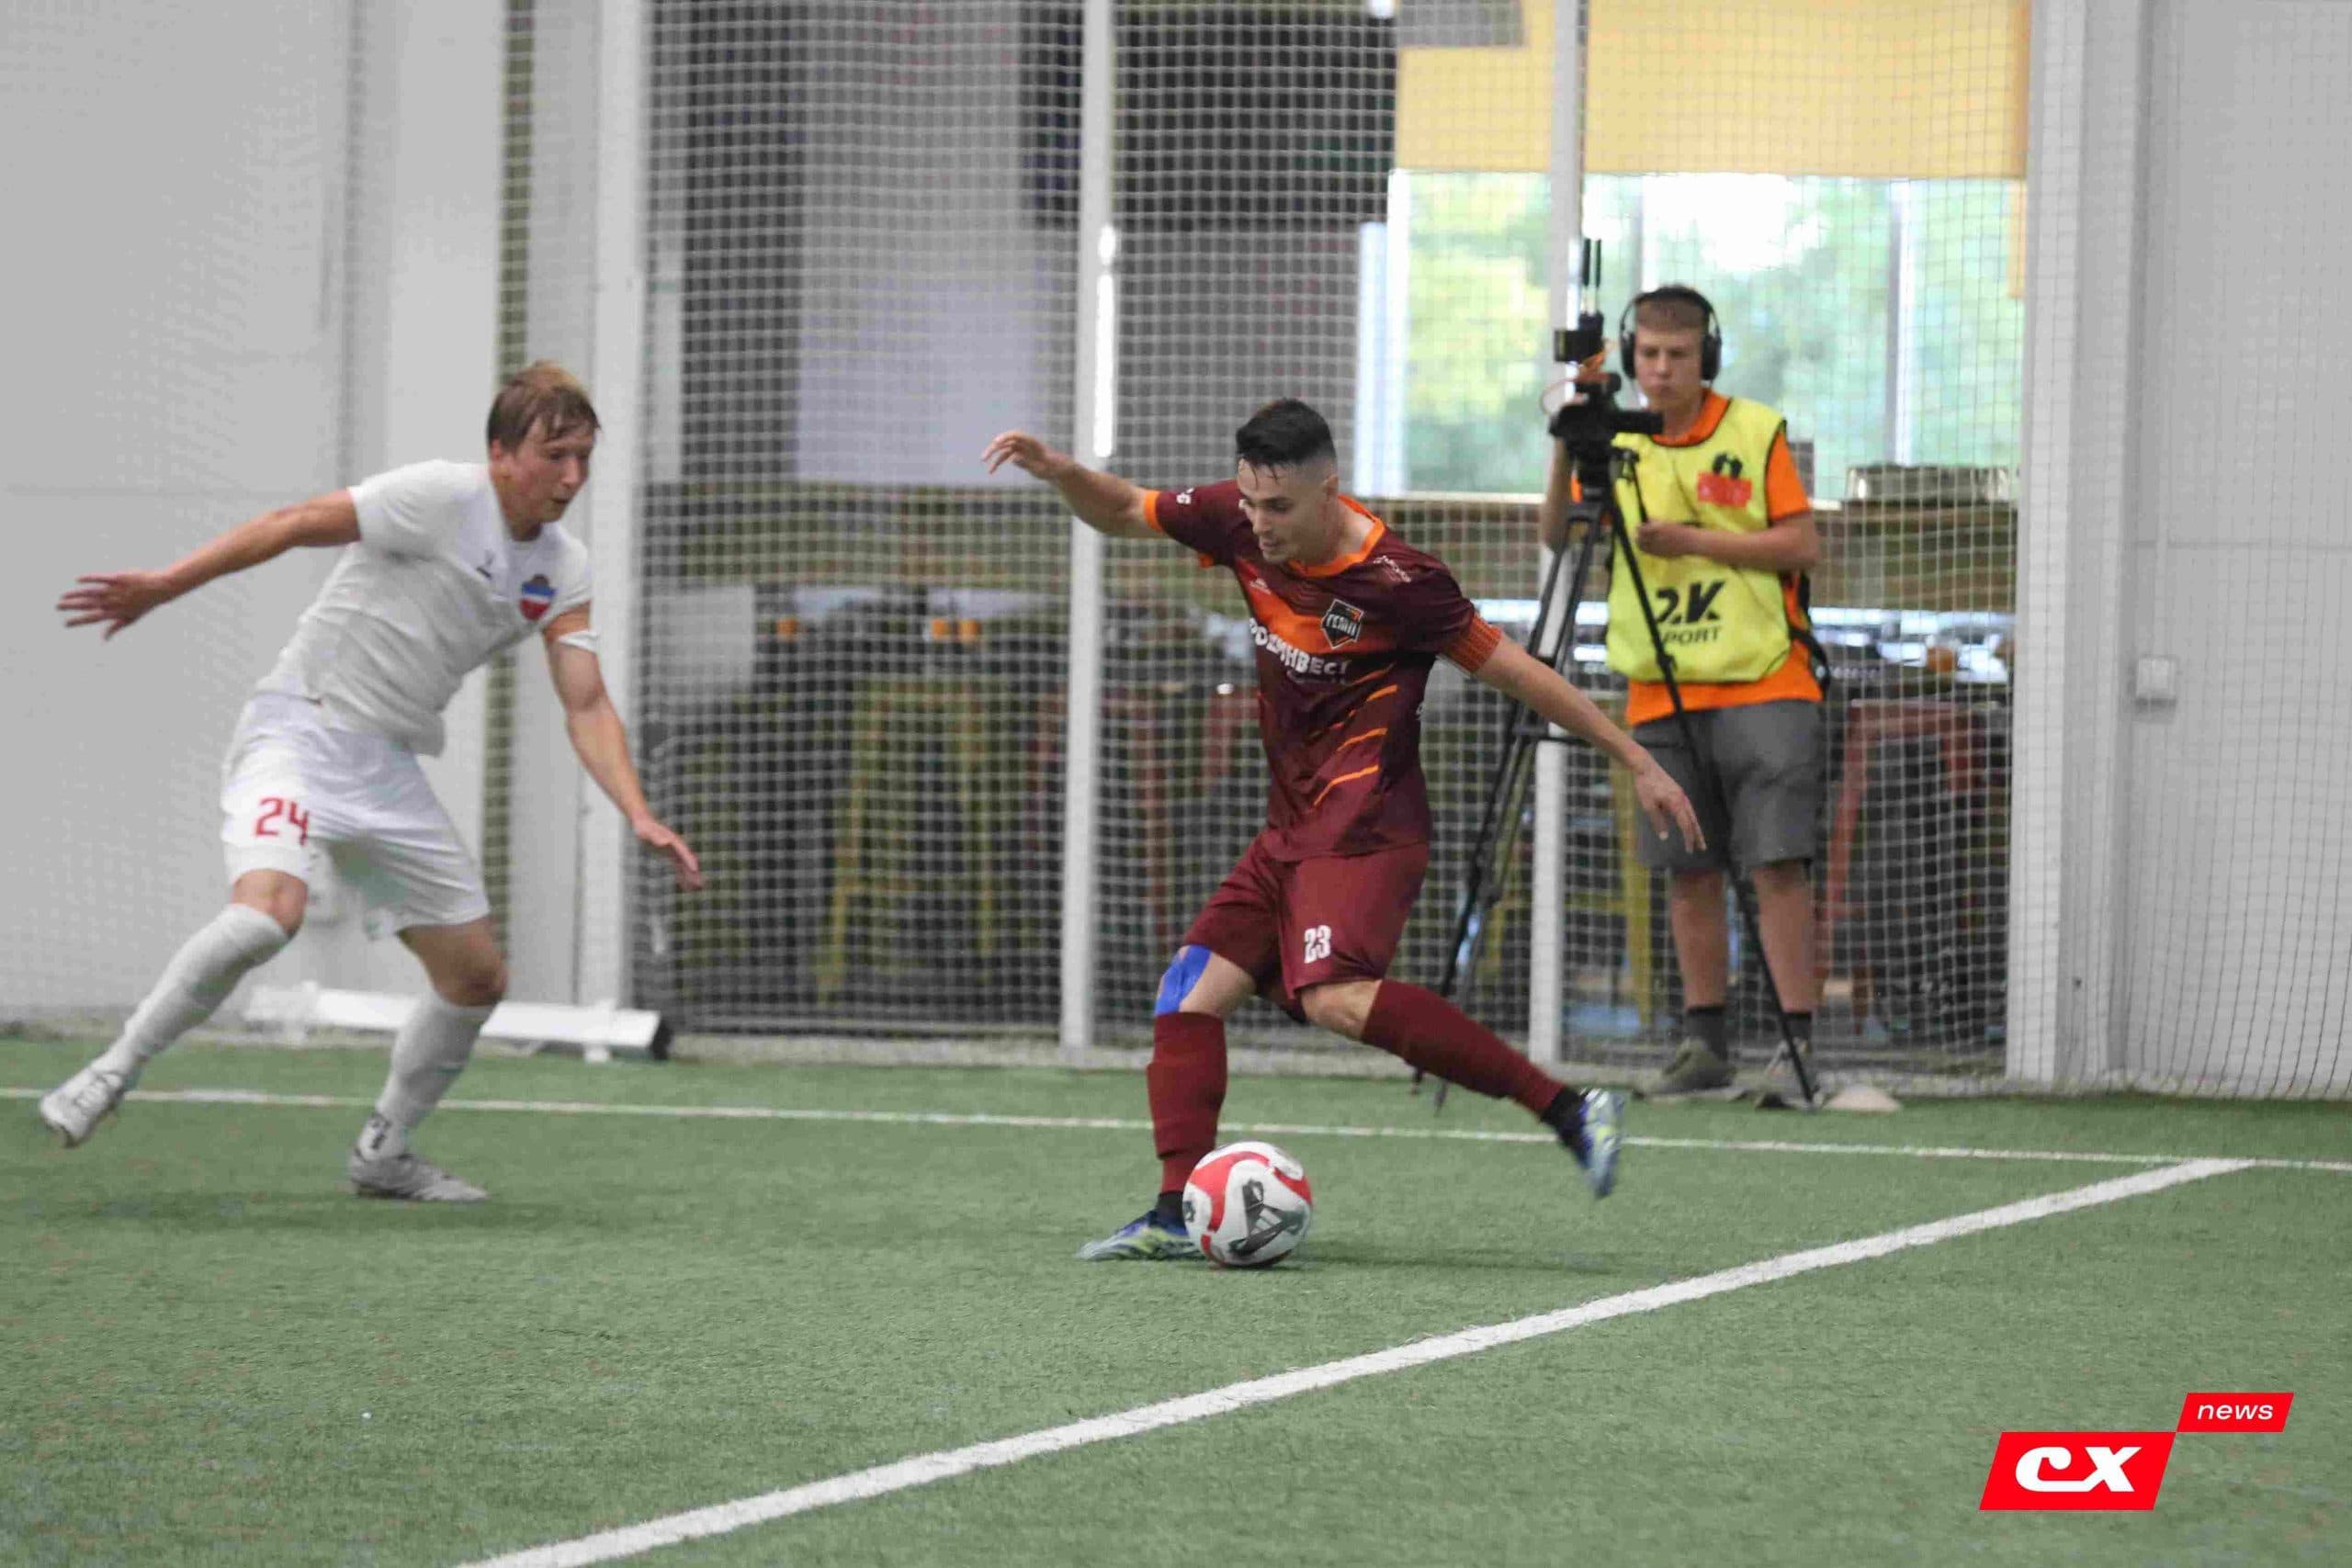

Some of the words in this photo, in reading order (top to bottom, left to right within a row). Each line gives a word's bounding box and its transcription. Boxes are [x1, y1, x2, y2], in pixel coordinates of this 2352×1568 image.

[1662, 627, 1722, 645] PORT
[255, 797, 309, 847] 24
[1304, 925, 1331, 964] 23
